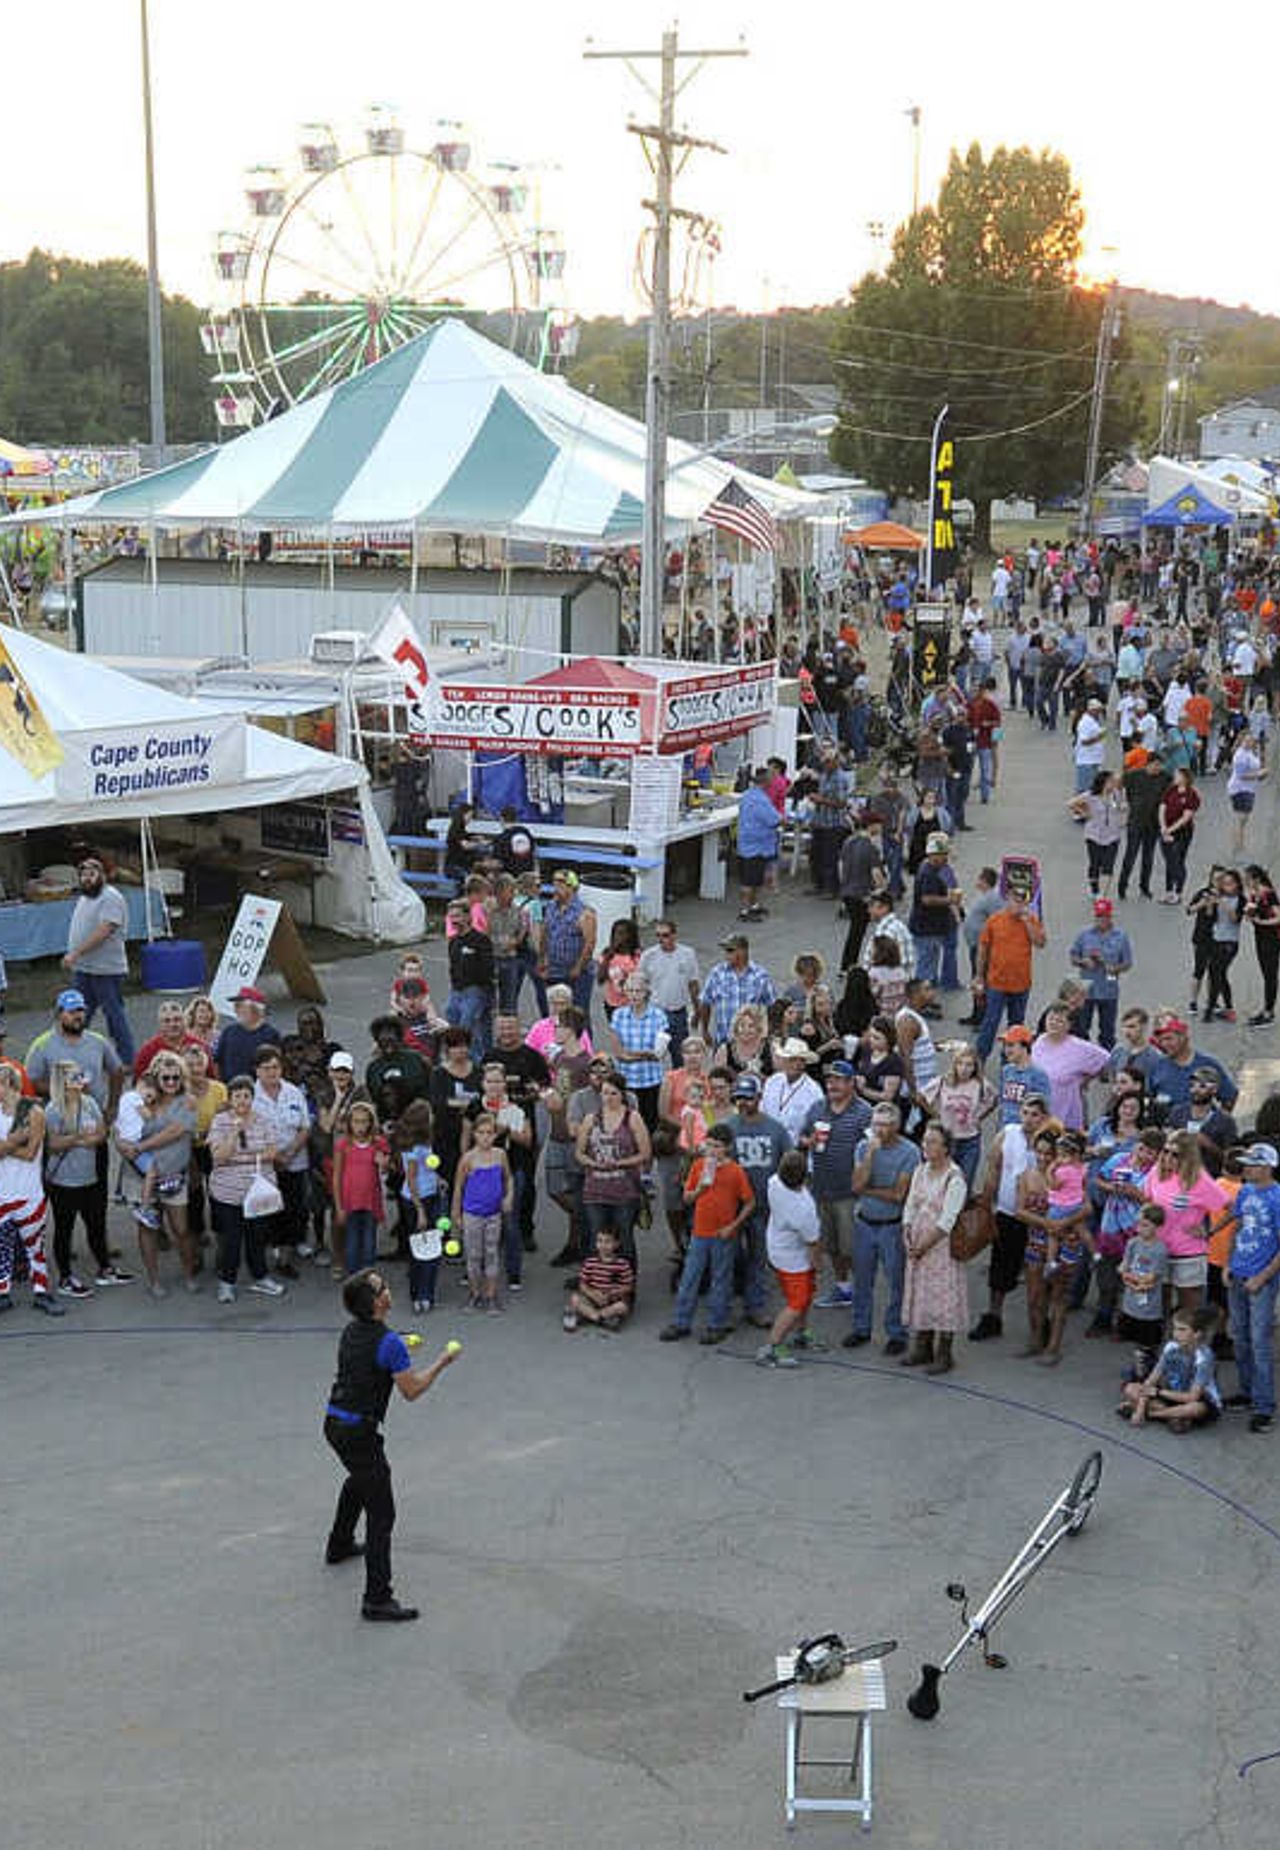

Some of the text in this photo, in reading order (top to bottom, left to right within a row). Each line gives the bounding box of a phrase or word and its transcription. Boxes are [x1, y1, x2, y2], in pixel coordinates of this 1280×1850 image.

[936, 441, 955, 550] ATM
[90, 734, 212, 767] Cape County
[95, 763, 210, 796] Republicans
